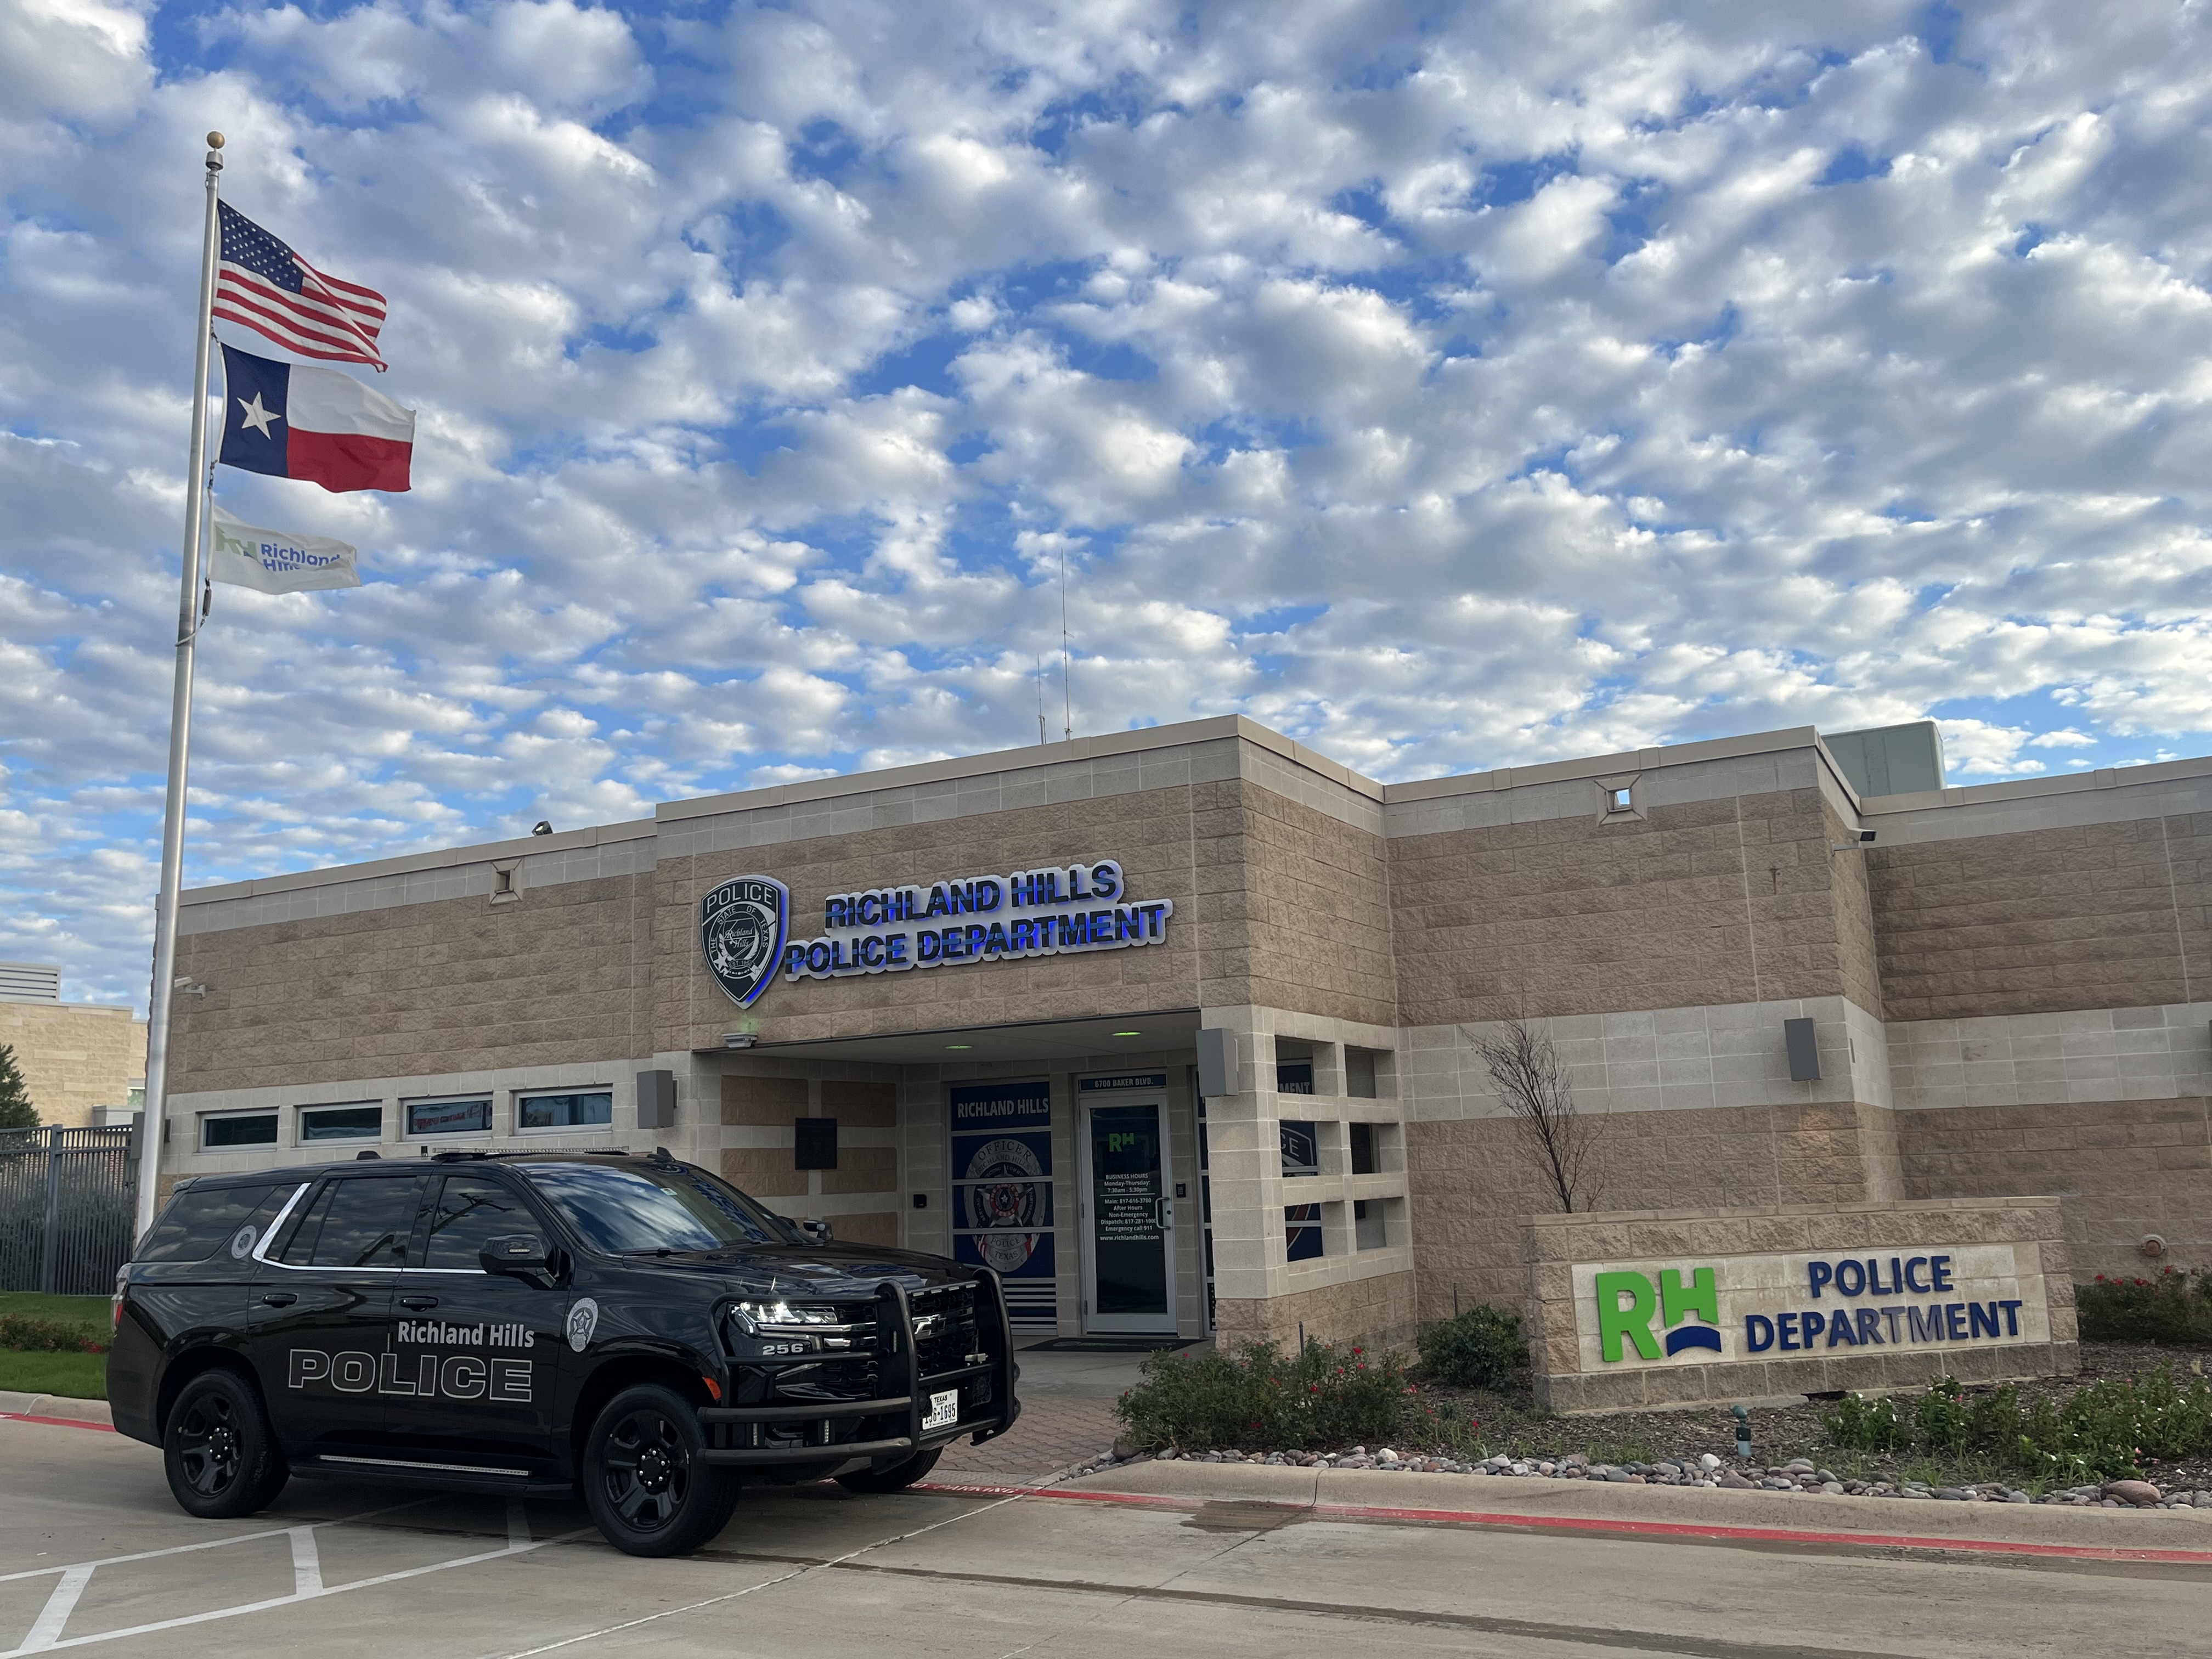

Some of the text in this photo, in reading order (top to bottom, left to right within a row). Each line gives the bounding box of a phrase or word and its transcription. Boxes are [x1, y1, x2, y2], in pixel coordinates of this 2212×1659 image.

[707, 883, 772, 914] POLICE
[825, 865, 1116, 929] RICHLAND HILLS
[717, 906, 736, 925] STATE
[747, 905, 757, 914] OF
[759, 918, 769, 948] TEXAS
[725, 926, 754, 939] Richland
[733, 938, 749, 949] Hills
[785, 904, 1165, 974] POLICE DEPARTMENT
[958, 1098, 1049, 1118] RICHLAND HILLS
[978, 1141, 1031, 1161] OFFICER
[1109, 1132, 1135, 1153] RH
[978, 1154, 1030, 1174] RICHLAND HILLS
[991, 1237, 1021, 1247] POLICE
[995, 1250, 1018, 1260] TEXAS
[1808, 1256, 1954, 1298] POLICE
[1596, 1267, 1719, 1362] RH
[398, 1321, 535, 1347] Richland Hills
[1746, 1300, 2023, 1352] DEPARTMENT
[763, 1343, 804, 1355] 256
[288, 1349, 532, 1402] POLICE
[934, 1395, 947, 1403] TEXAS
